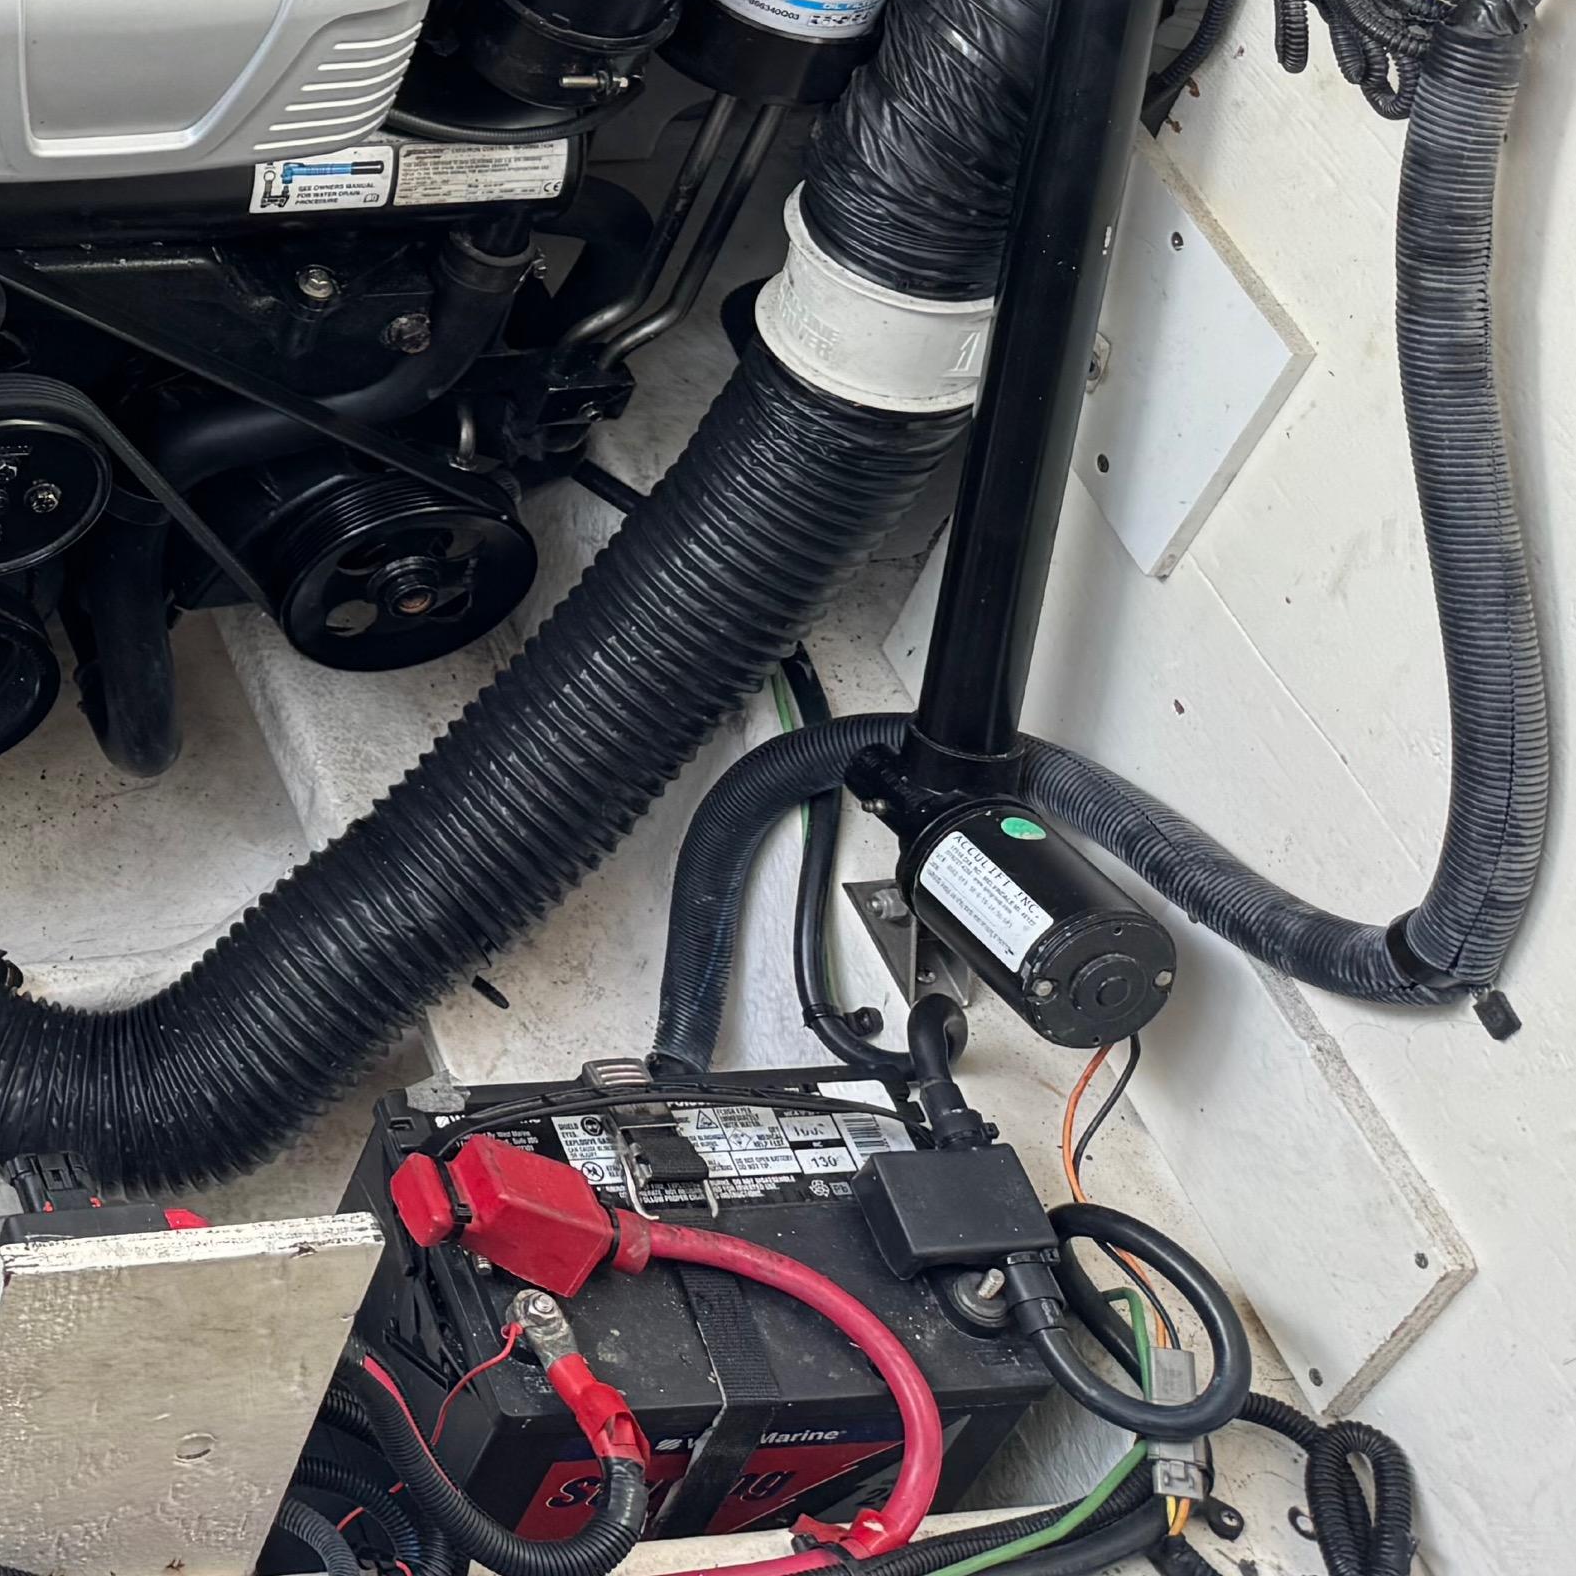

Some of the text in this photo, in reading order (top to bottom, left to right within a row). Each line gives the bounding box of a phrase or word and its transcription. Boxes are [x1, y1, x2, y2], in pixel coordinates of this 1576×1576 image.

[953, 835, 1040, 919] ACCULIFT INC.
[811, 1155, 837, 1168] 130
[759, 1429, 840, 1445] Marine
